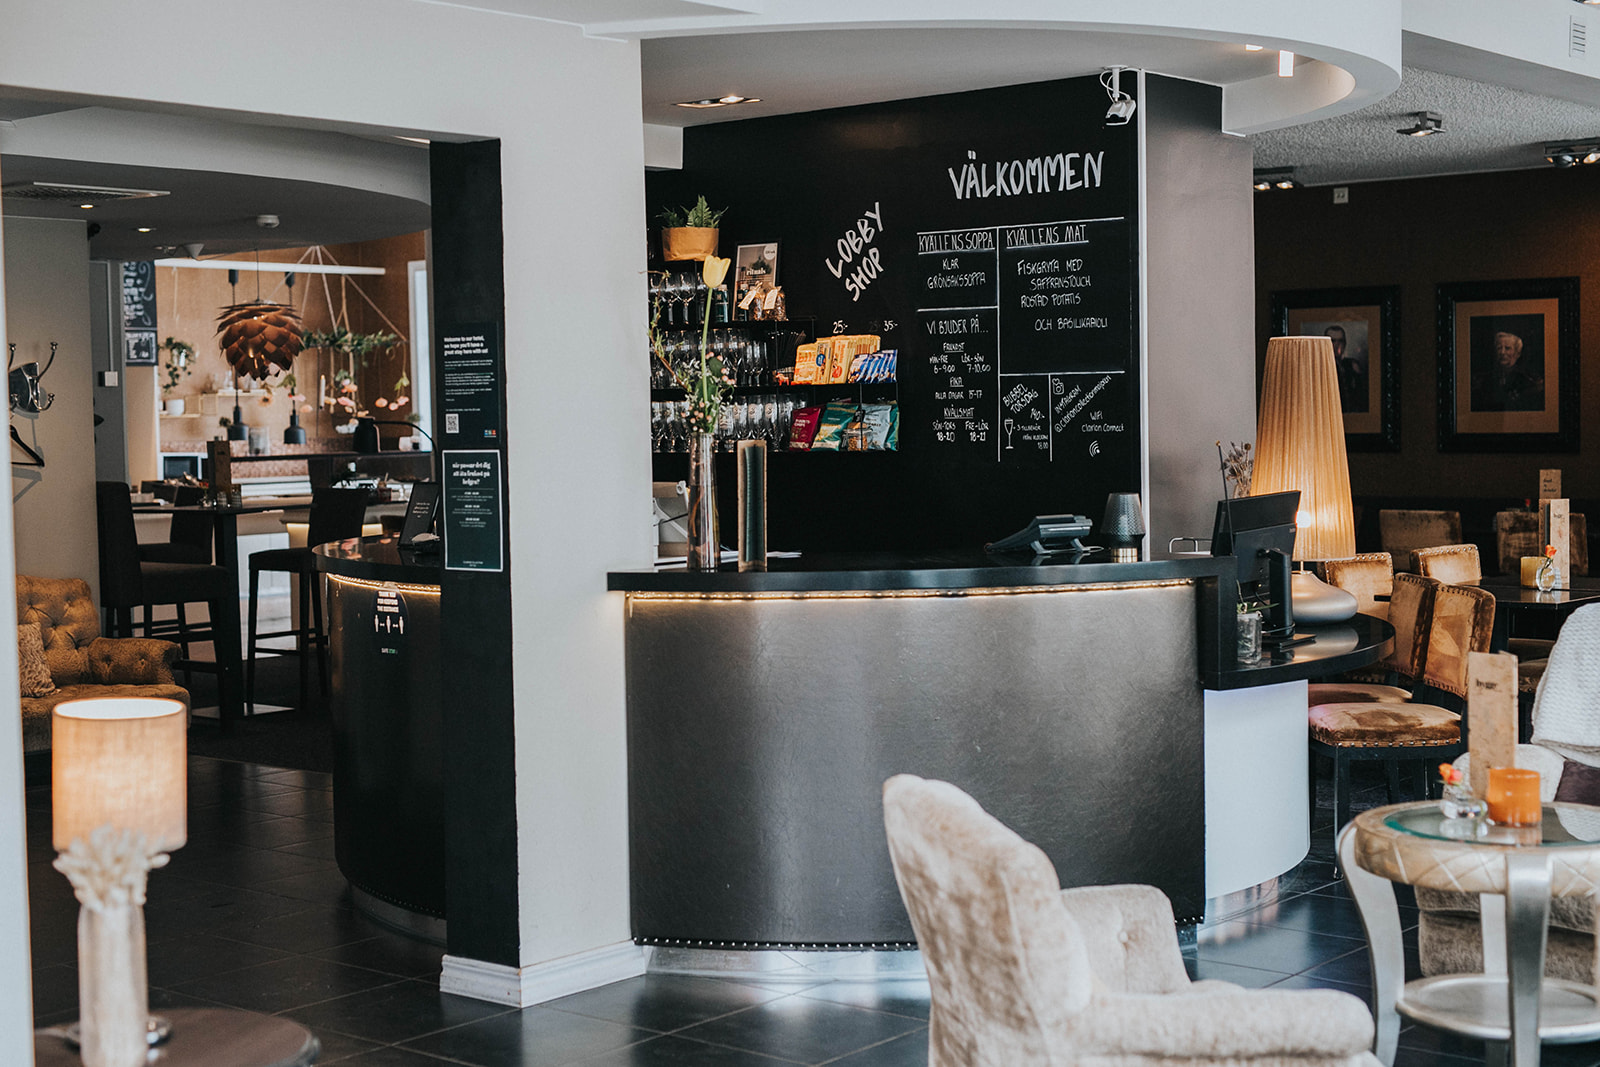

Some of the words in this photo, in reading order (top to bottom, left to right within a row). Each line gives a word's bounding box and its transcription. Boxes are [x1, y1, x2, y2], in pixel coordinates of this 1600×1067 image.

[948, 150, 1105, 200] VÄLKOMMEN
[825, 201, 884, 279] LOBBY
[1006, 226, 1060, 247] KVÄLLENS
[1064, 224, 1087, 243] MAT
[942, 257, 960, 271] KLAR
[1017, 258, 1060, 276] FISKGRYTA
[1066, 258, 1084, 273] MED
[845, 246, 885, 302] SHOP
[1050, 292, 1082, 306] POTATIS
[925, 320, 937, 335] VI
[938, 319, 968, 335] BJUDER
[1034, 317, 1053, 332] OCH
